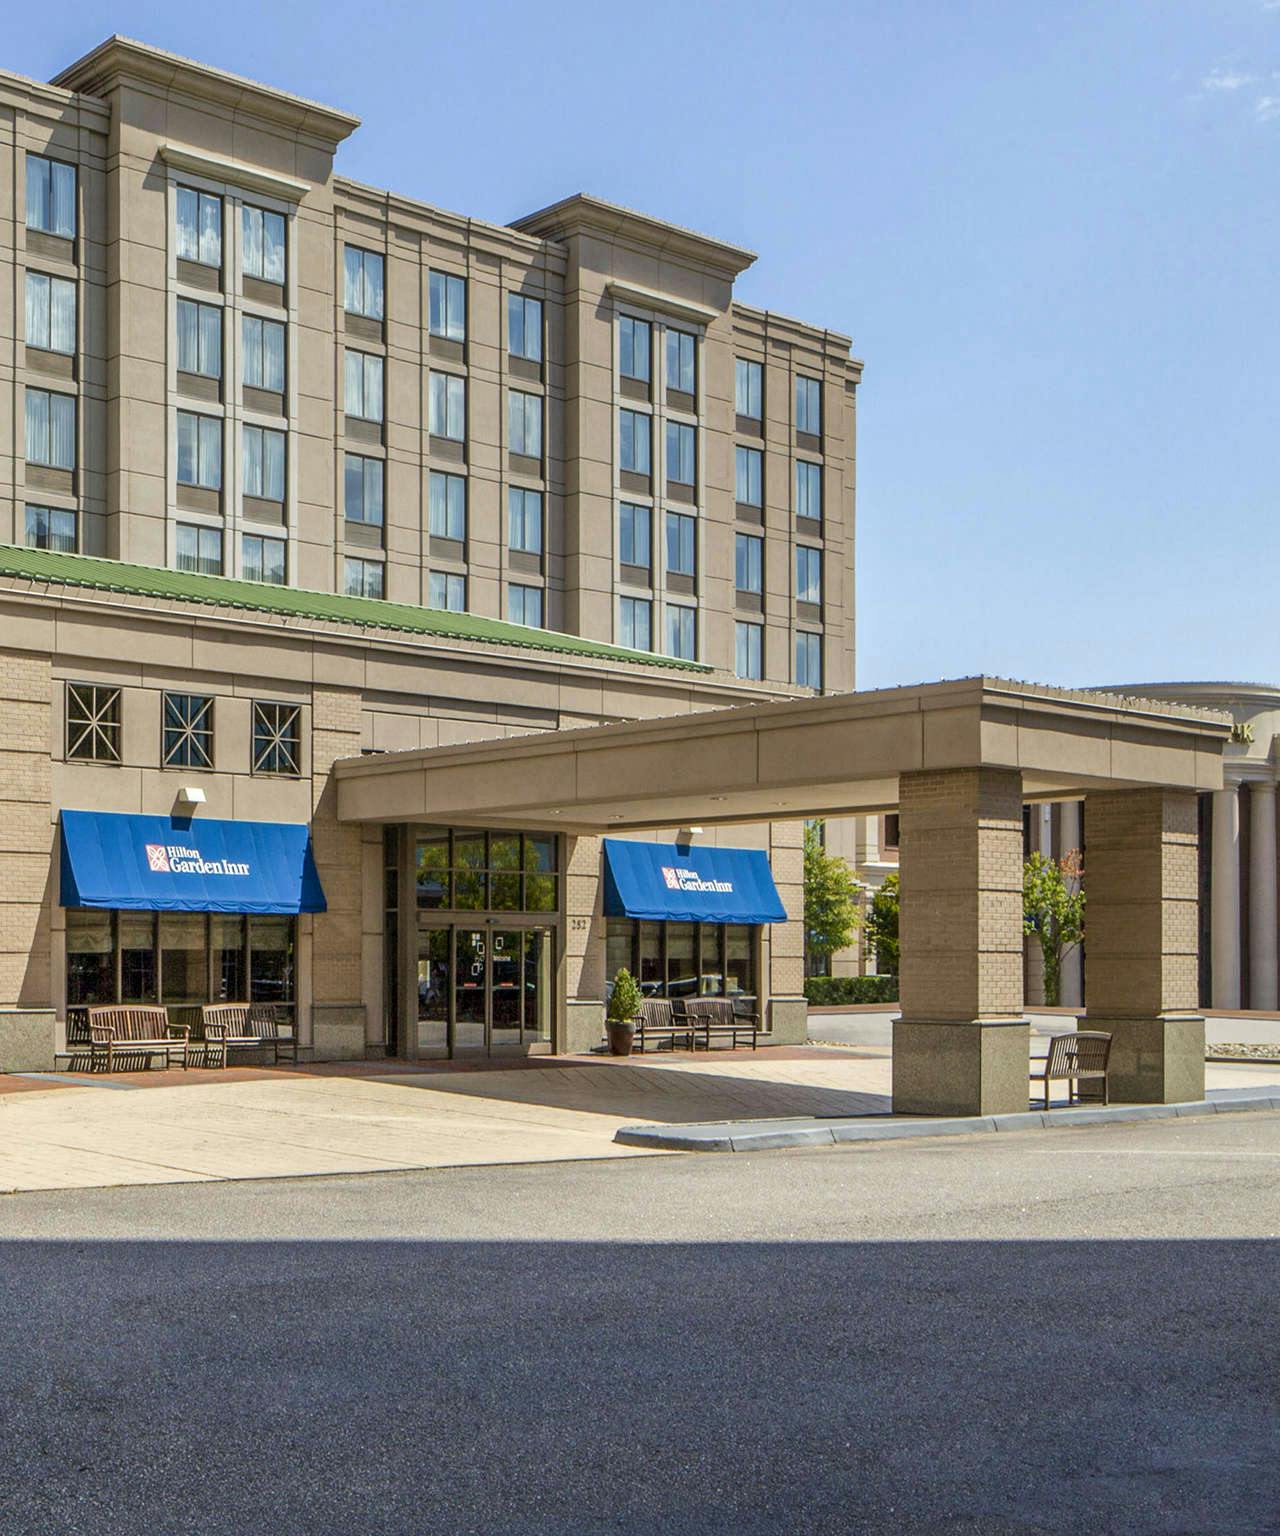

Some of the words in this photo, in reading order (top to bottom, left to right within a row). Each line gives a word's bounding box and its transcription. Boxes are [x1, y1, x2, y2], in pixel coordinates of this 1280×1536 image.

[166, 845, 200, 859] Hilton
[169, 857, 223, 874] Garden
[221, 859, 250, 875] Inn
[679, 878, 716, 891] Garden
[713, 879, 734, 893] Inn
